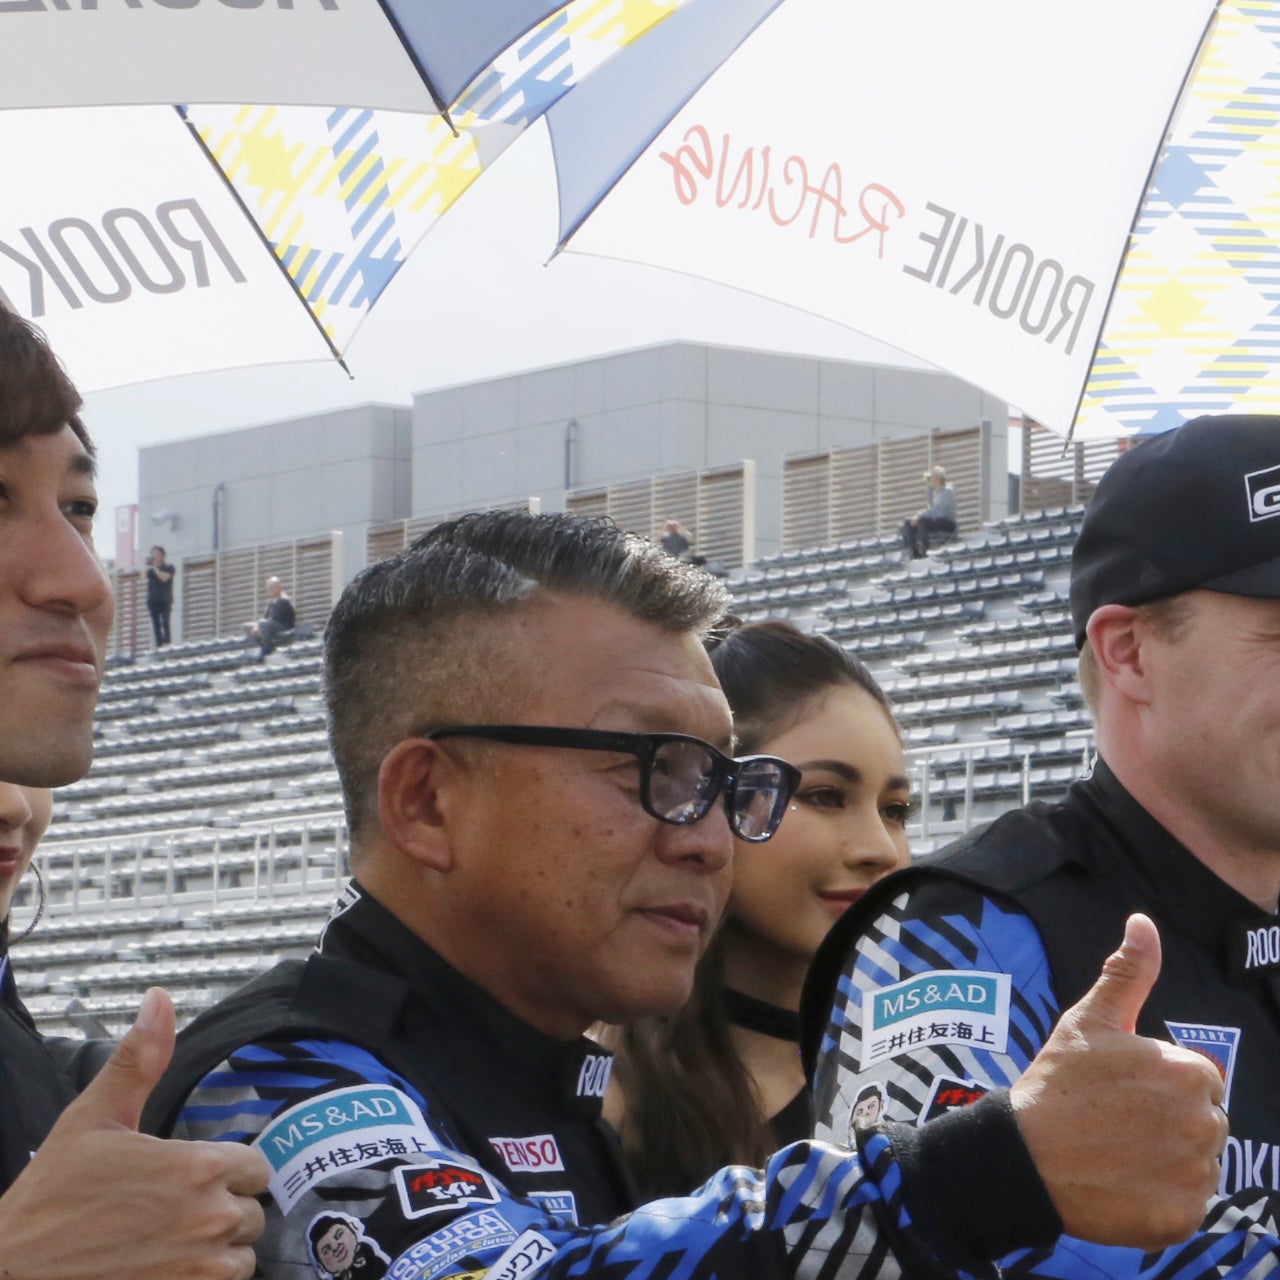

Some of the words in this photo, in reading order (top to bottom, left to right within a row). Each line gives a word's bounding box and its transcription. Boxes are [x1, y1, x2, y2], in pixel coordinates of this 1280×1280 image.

[884, 983, 987, 1018] MS&AD
[870, 1022, 995, 1059] 三井住友海上
[1181, 1027, 1227, 1042] SPARX
[273, 1098, 397, 1154] MS&AD
[283, 1136, 427, 1198] 三井住友海上
